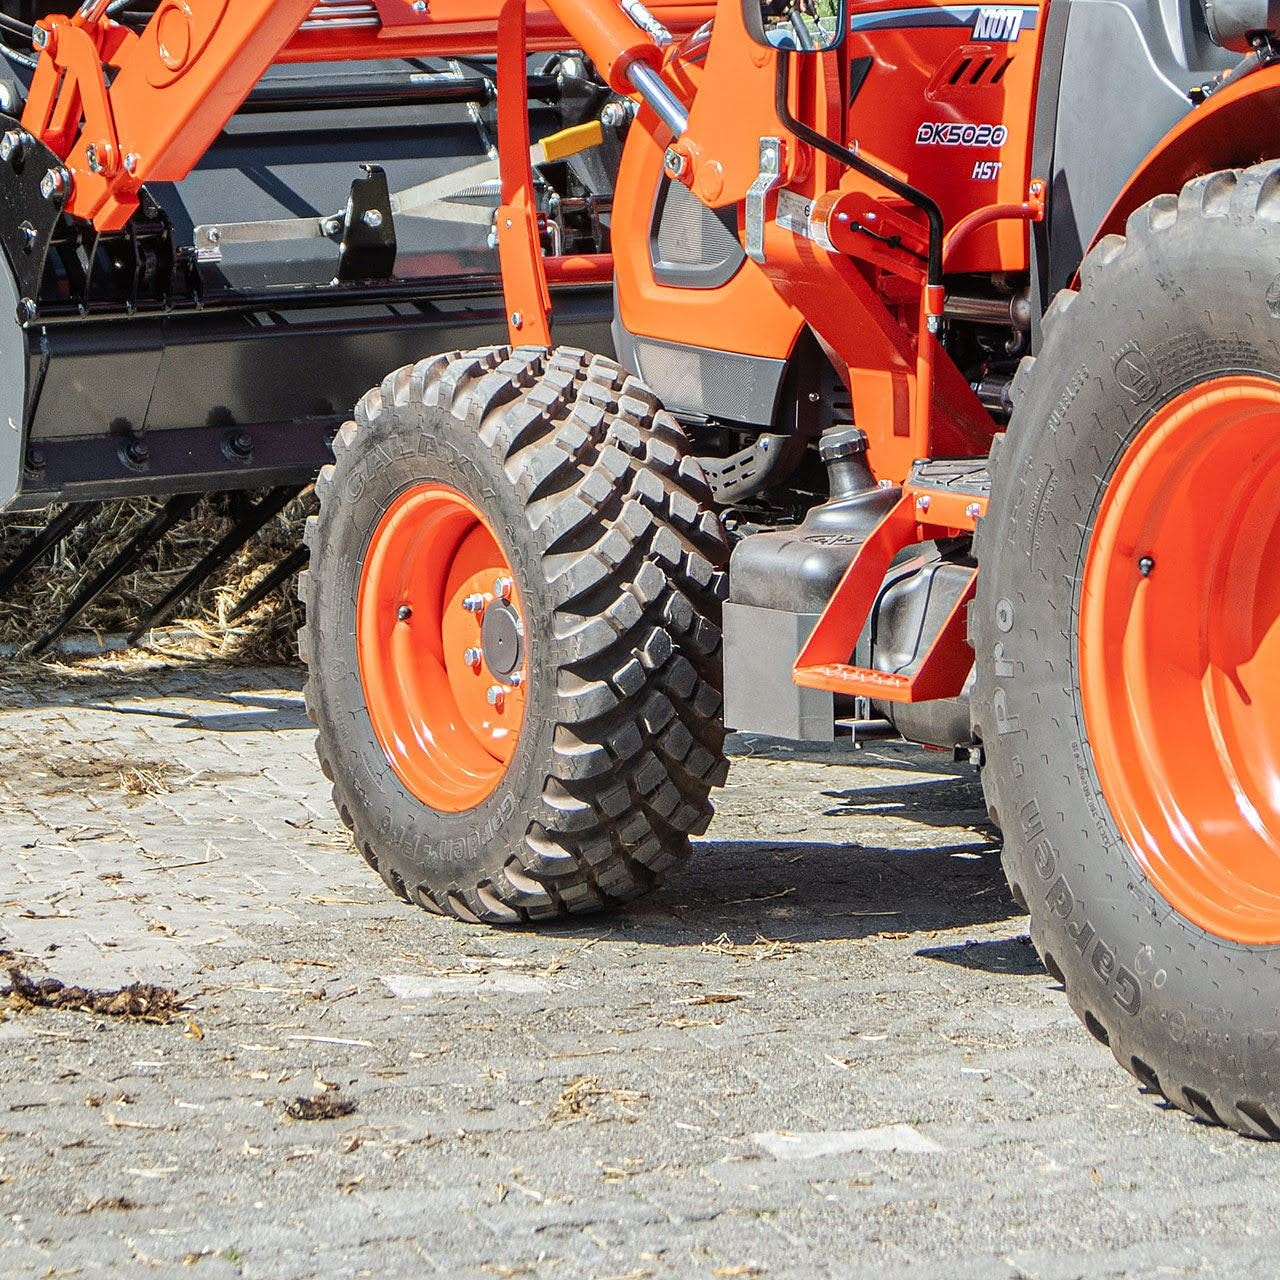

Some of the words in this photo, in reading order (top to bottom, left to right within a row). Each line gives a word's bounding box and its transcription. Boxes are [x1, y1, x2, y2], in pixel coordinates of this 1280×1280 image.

[972, 7, 1024, 42] KIOTI
[915, 122, 1008, 148] DK5020
[971, 160, 1003, 181] HST
[344, 432, 497, 505] GALAXY
